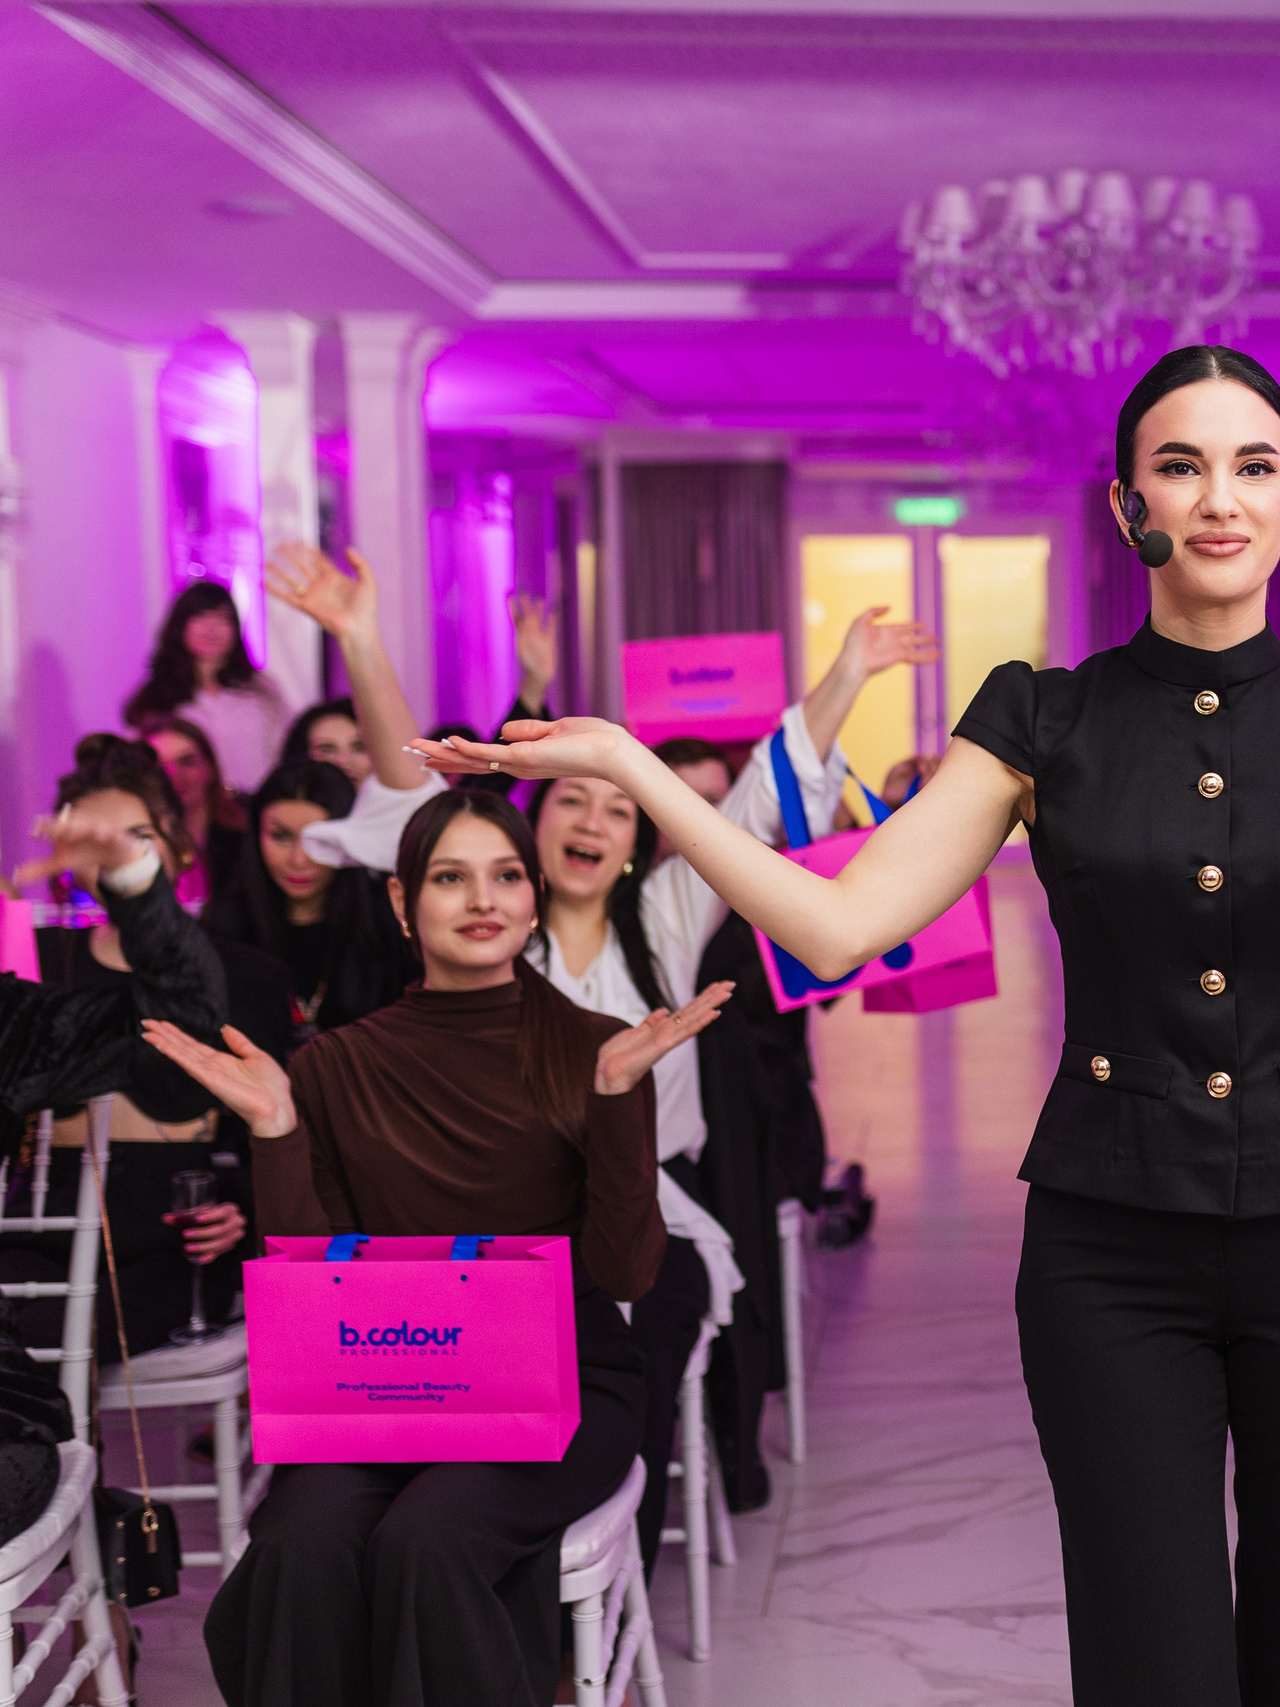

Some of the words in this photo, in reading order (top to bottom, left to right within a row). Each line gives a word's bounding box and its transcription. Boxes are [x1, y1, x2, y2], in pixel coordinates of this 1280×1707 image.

[339, 1320, 463, 1347] b.colour
[340, 1348, 459, 1356] PROFESSIONAL
[337, 1382, 419, 1391] Professional
[423, 1382, 471, 1393] Beauty
[368, 1392, 446, 1403] Community
